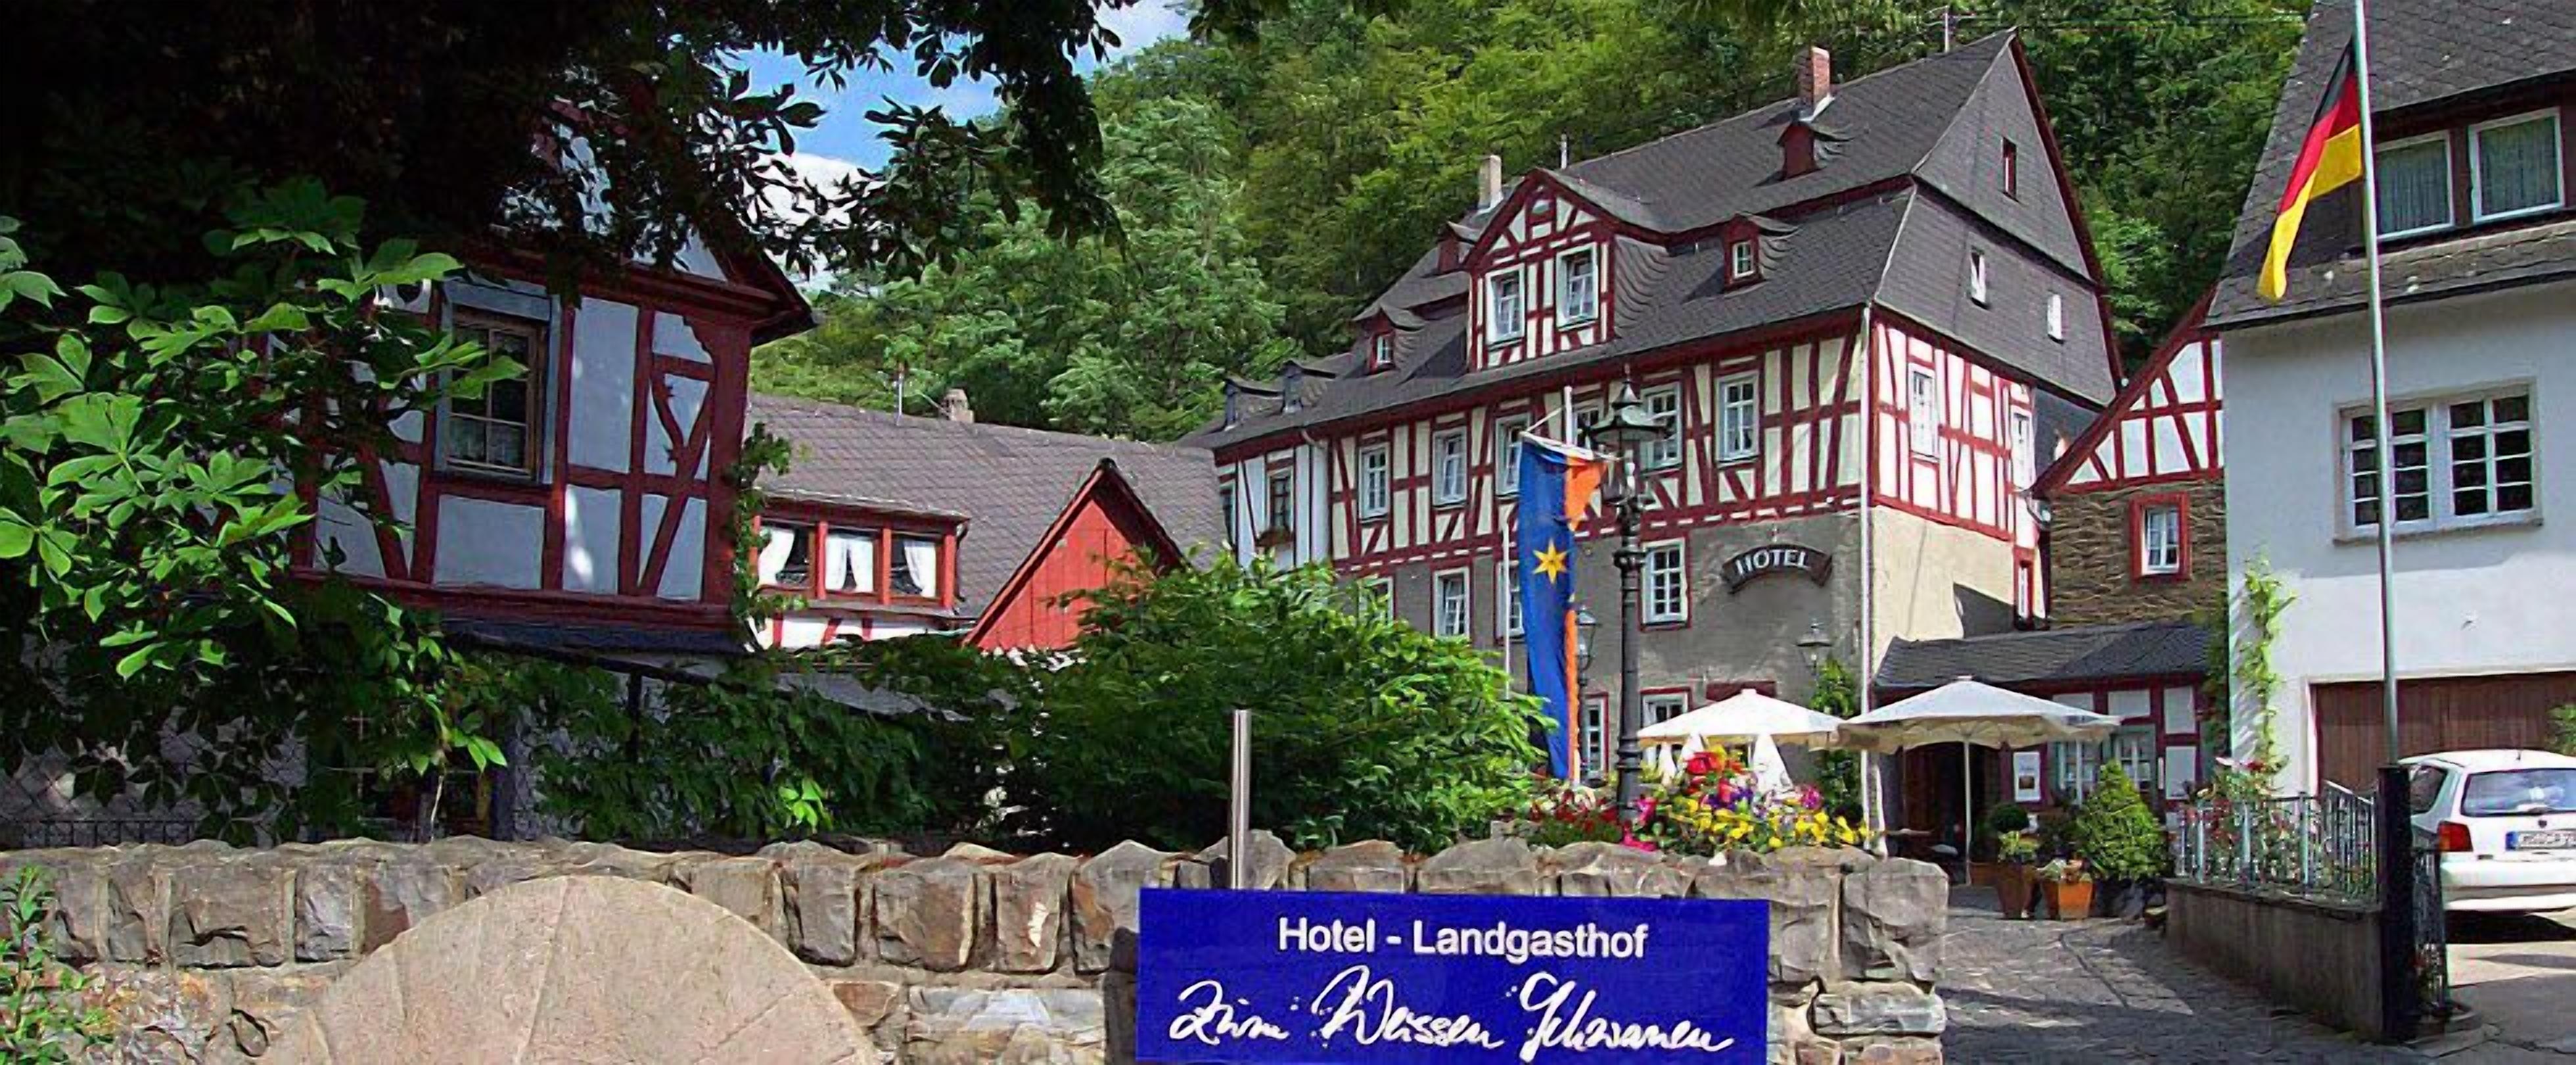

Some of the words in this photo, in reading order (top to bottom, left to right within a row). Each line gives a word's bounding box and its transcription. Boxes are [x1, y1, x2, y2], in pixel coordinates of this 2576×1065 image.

[1735, 549, 1810, 577] HOTEL
[1278, 916, 1376, 953] Hotel
[1412, 919, 1649, 965] Landgasthof
[1310, 964, 1506, 1051] Weissen
[1518, 970, 1736, 1064] Schwanen
